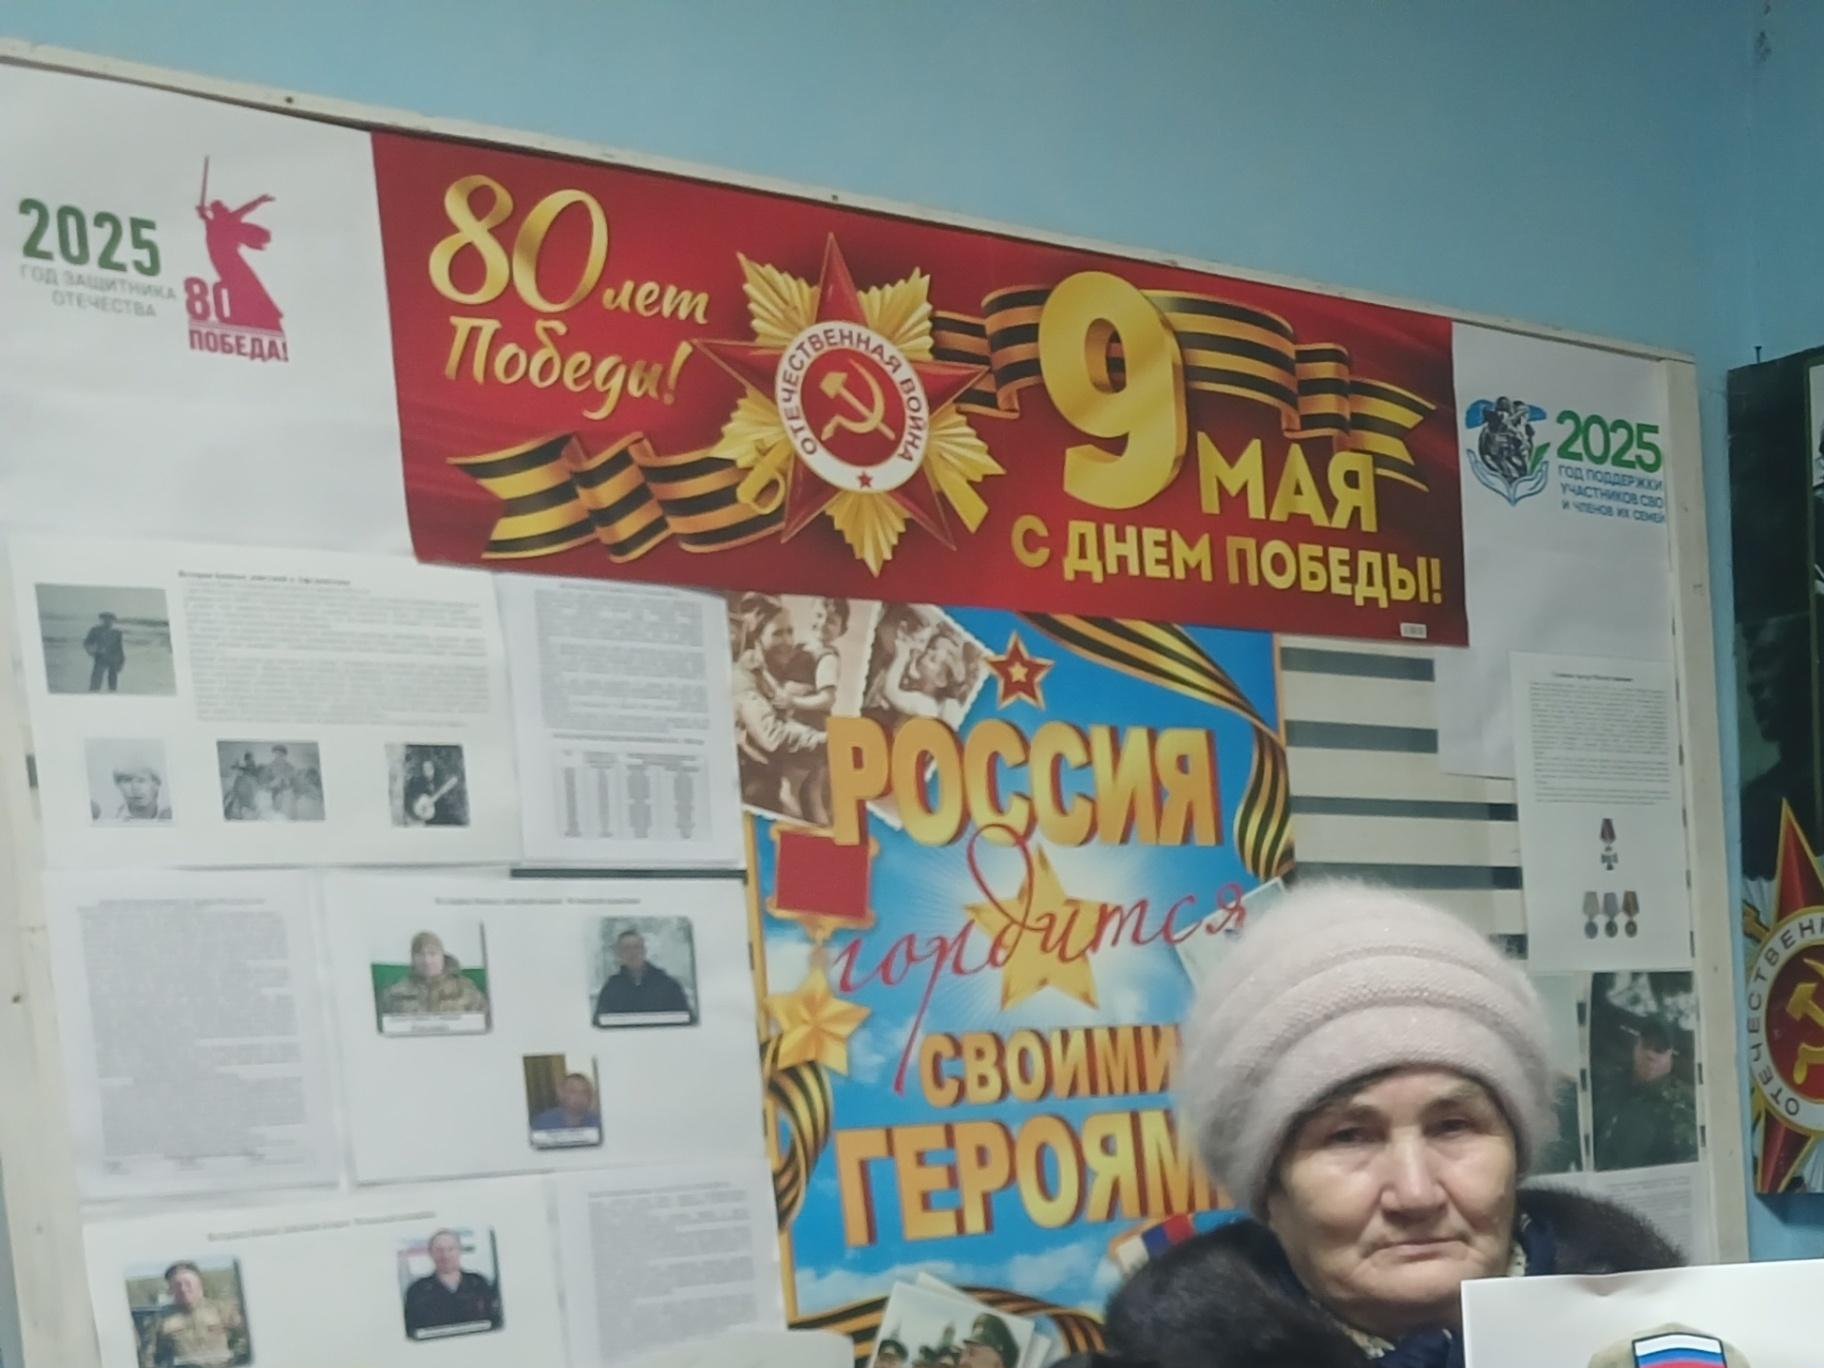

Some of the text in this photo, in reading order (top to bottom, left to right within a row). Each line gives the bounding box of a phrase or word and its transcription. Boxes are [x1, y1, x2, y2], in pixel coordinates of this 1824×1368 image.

[19, 198, 161, 277] 2025
[429, 174, 709, 324] 80 лет
[20, 264, 177, 301] ГОД ЗАЩИТНИКА
[50, 289, 157, 318] ОТЕЧЕСТВА
[184, 276, 233, 324] 80
[189, 328, 289, 363] ПОБЕДА!
[444, 315, 693, 420] Победы!
[782, 328, 902, 456] ОТЕЧЕСТВЕННАЯ
[1038, 270, 1377, 533] 9 МАЯ
[1556, 410, 1662, 473] 2025
[1558, 465, 1663, 489] ГОД ПОДДЕРЖКИ
[1561, 483, 1663, 508] УЧАСТНИКОВ СВО
[1562, 500, 1570, 510] И
[1572, 503, 1613, 517] ЧЛЕНОВ
[1617, 508, 1630, 518] ИХ
[1011, 514, 1442, 607] С ДНЕМ ПОБЕДЫ!
[827, 716, 1223, 846] РОССИЯ
[837, 824, 1247, 1094] гордится
[836, 1110, 1236, 1246] ГЕРОЯМ
